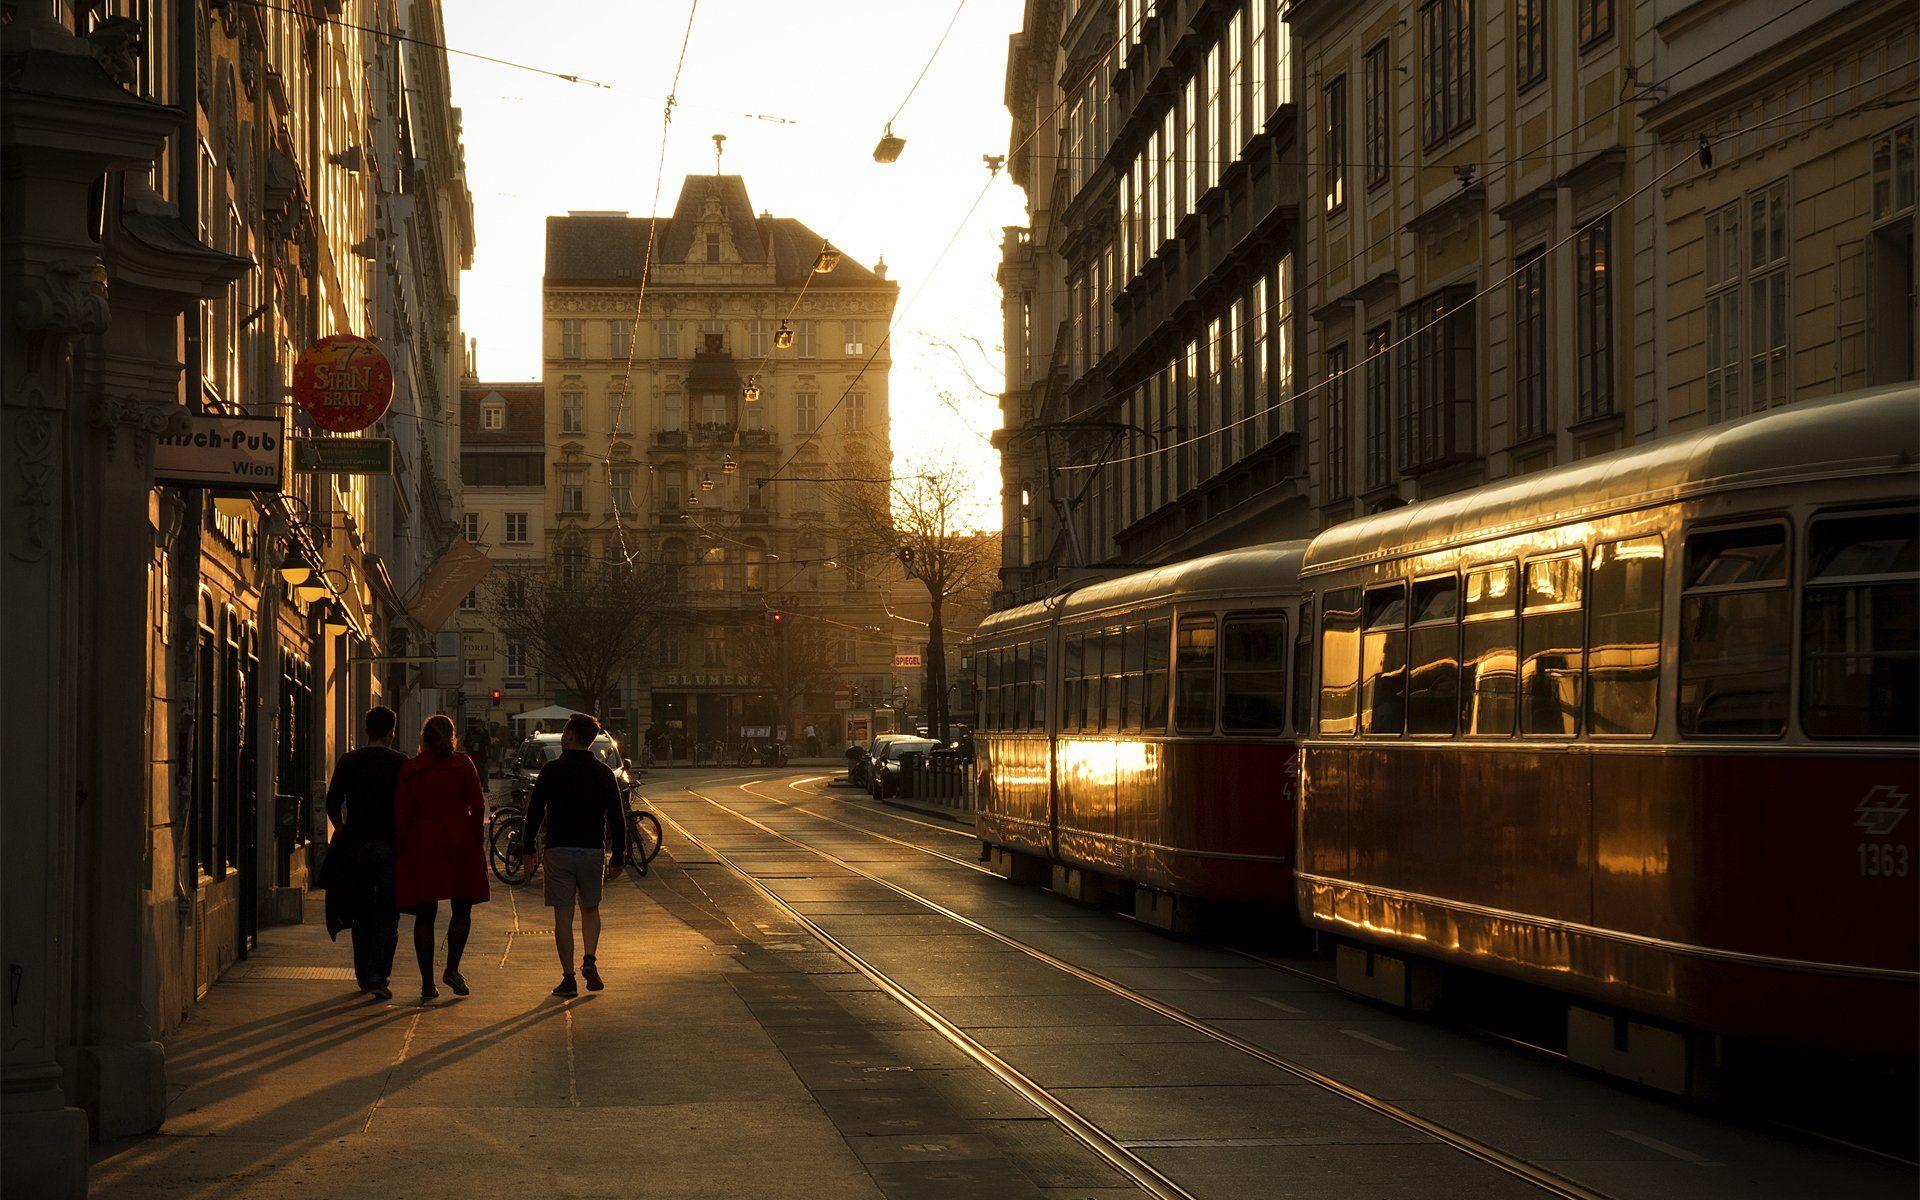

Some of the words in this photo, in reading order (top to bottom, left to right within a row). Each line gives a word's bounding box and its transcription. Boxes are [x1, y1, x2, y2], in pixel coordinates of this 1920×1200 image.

[331, 342, 359, 371] 7
[233, 461, 274, 476] Wien
[896, 656, 921, 666] SPIEGEL
[668, 674, 749, 686] BLUMEN
[1856, 842, 1910, 878] 1363
